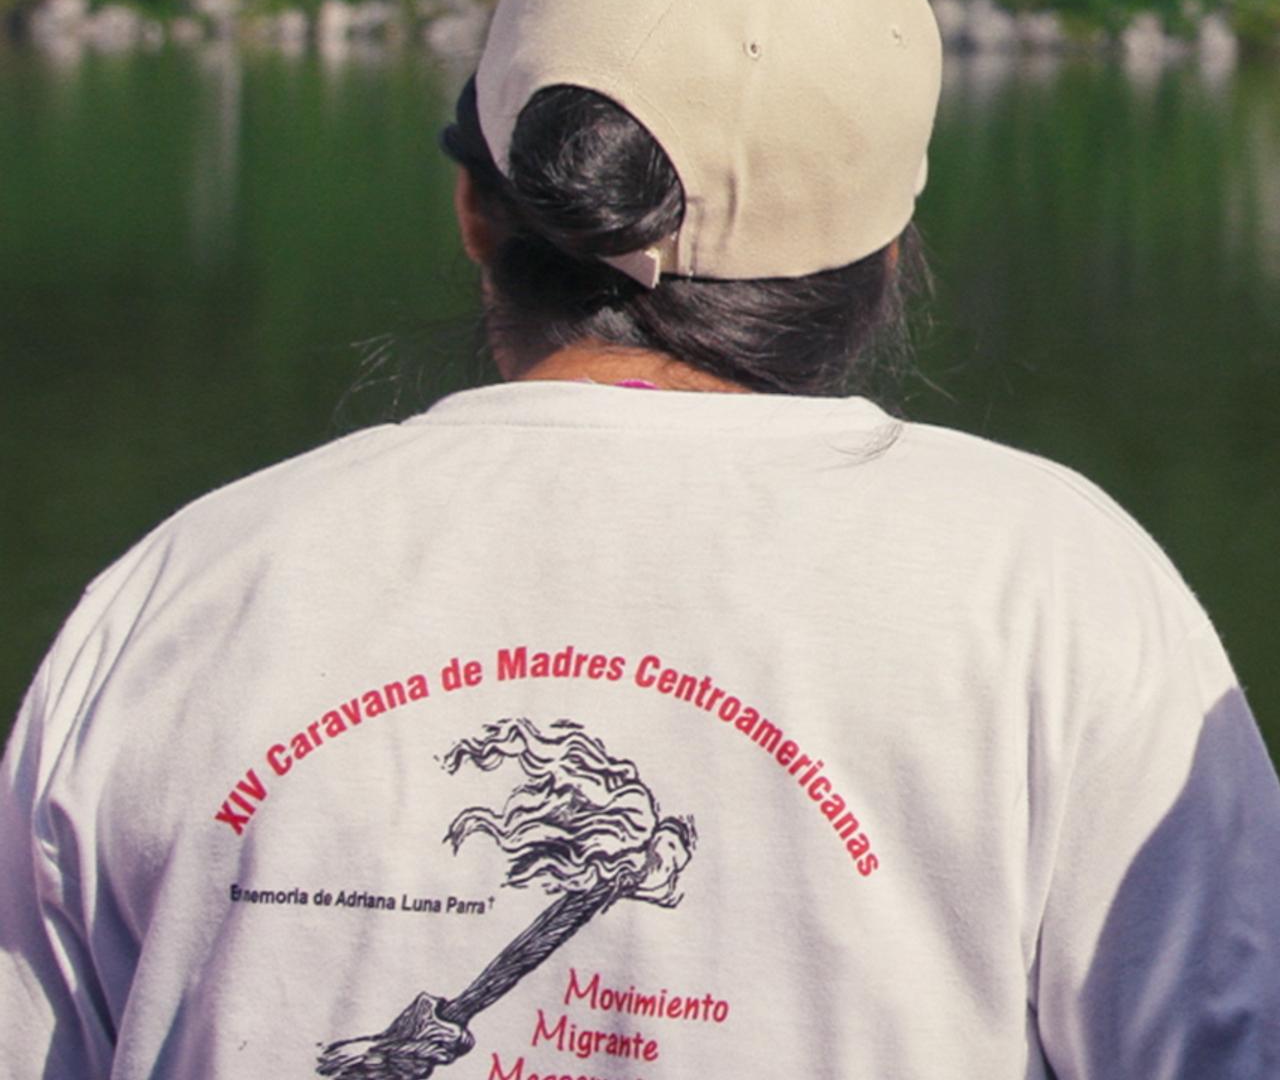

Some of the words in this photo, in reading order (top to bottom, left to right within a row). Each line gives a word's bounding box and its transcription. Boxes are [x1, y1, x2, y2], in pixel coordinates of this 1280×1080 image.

[214, 768, 268, 836] XIV
[265, 674, 430, 777] Caravana
[440, 656, 484, 693] de
[496, 645, 628, 682] Madres
[633, 653, 880, 877] Centroamericanas
[313, 889, 333, 907] de
[334, 890, 397, 911] Adriana
[401, 894, 442, 914] Luna
[563, 968, 730, 1024] Movimiento
[531, 1009, 660, 1063] Migrante
